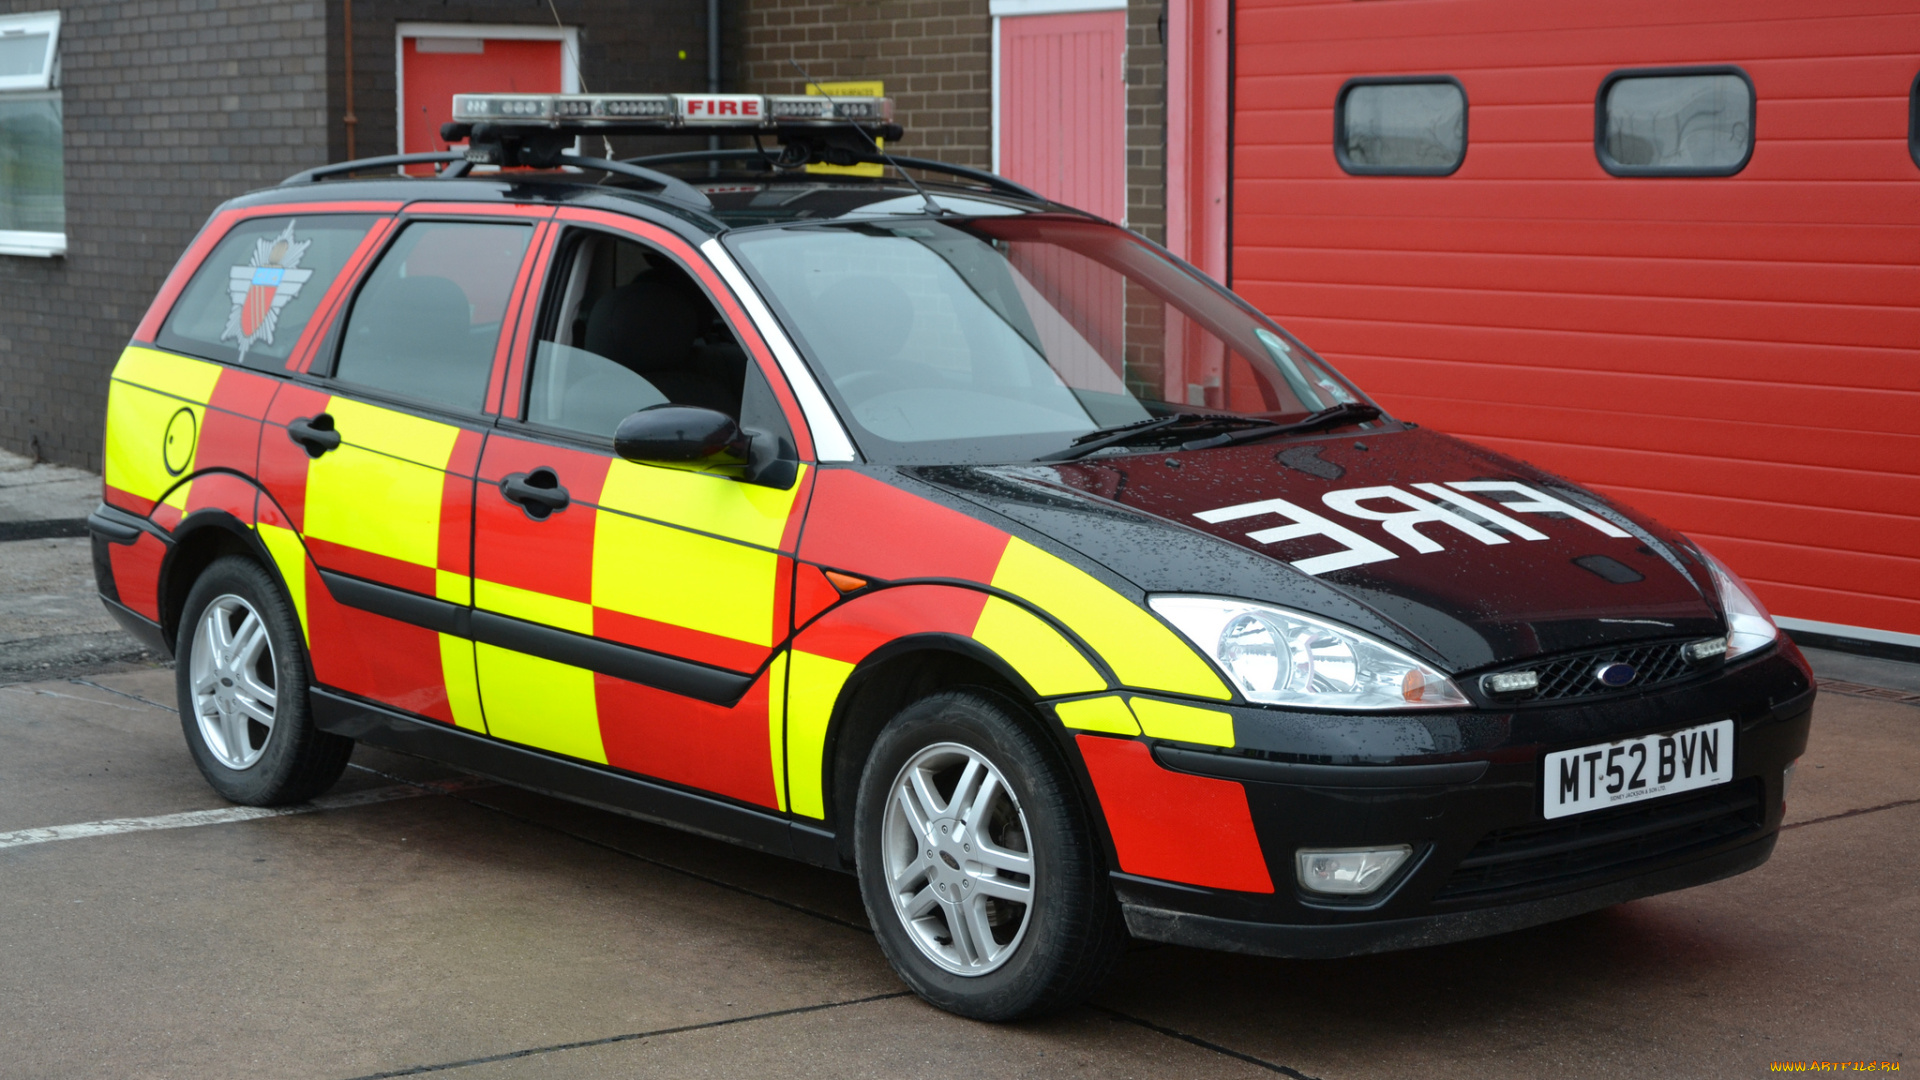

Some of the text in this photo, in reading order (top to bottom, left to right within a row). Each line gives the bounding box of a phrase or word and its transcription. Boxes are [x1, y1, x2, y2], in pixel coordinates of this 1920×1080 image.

[688, 100, 758, 115] FIRE
[1559, 728, 1719, 805] MT52 BVN
[1625, 789, 1645, 798] JACKSON
